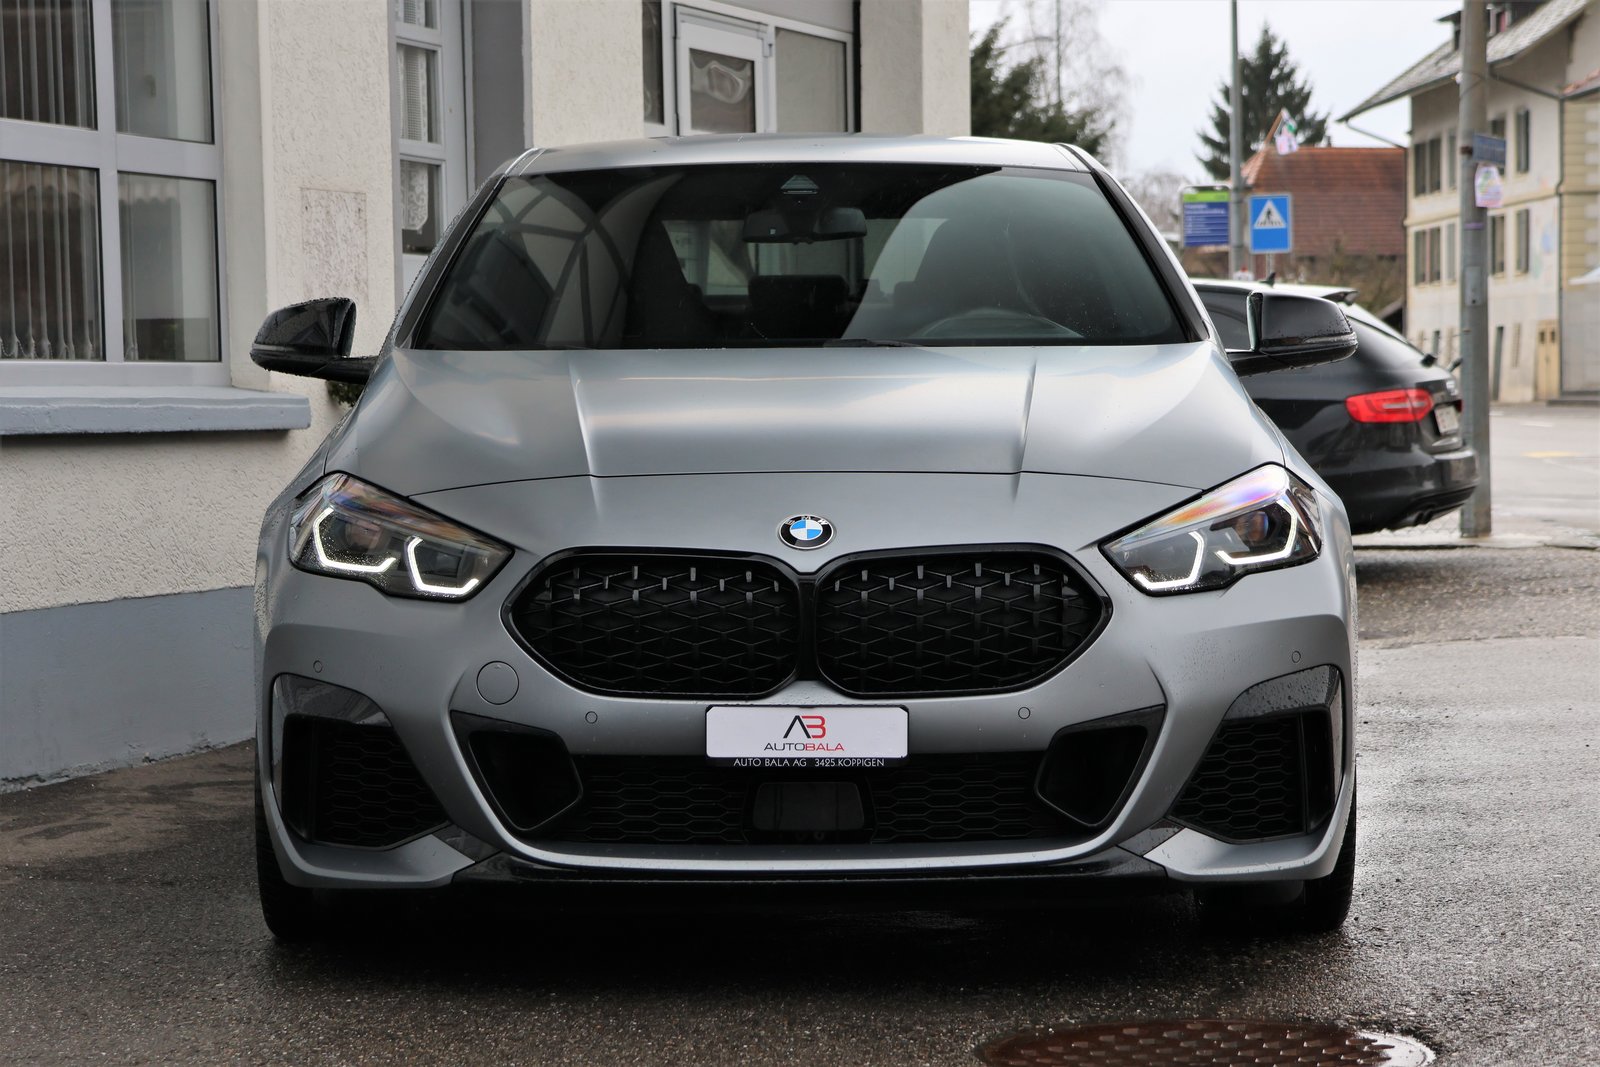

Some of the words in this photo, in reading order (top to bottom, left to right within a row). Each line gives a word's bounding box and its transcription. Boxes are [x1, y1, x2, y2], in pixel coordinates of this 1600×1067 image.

[763, 743, 845, 751] AUTOBALA
[733, 758, 762, 767] AUTO
[764, 758, 790, 767] BALA
[792, 758, 807, 767] AG
[837, 758, 885, 767] KOPPIGEN
